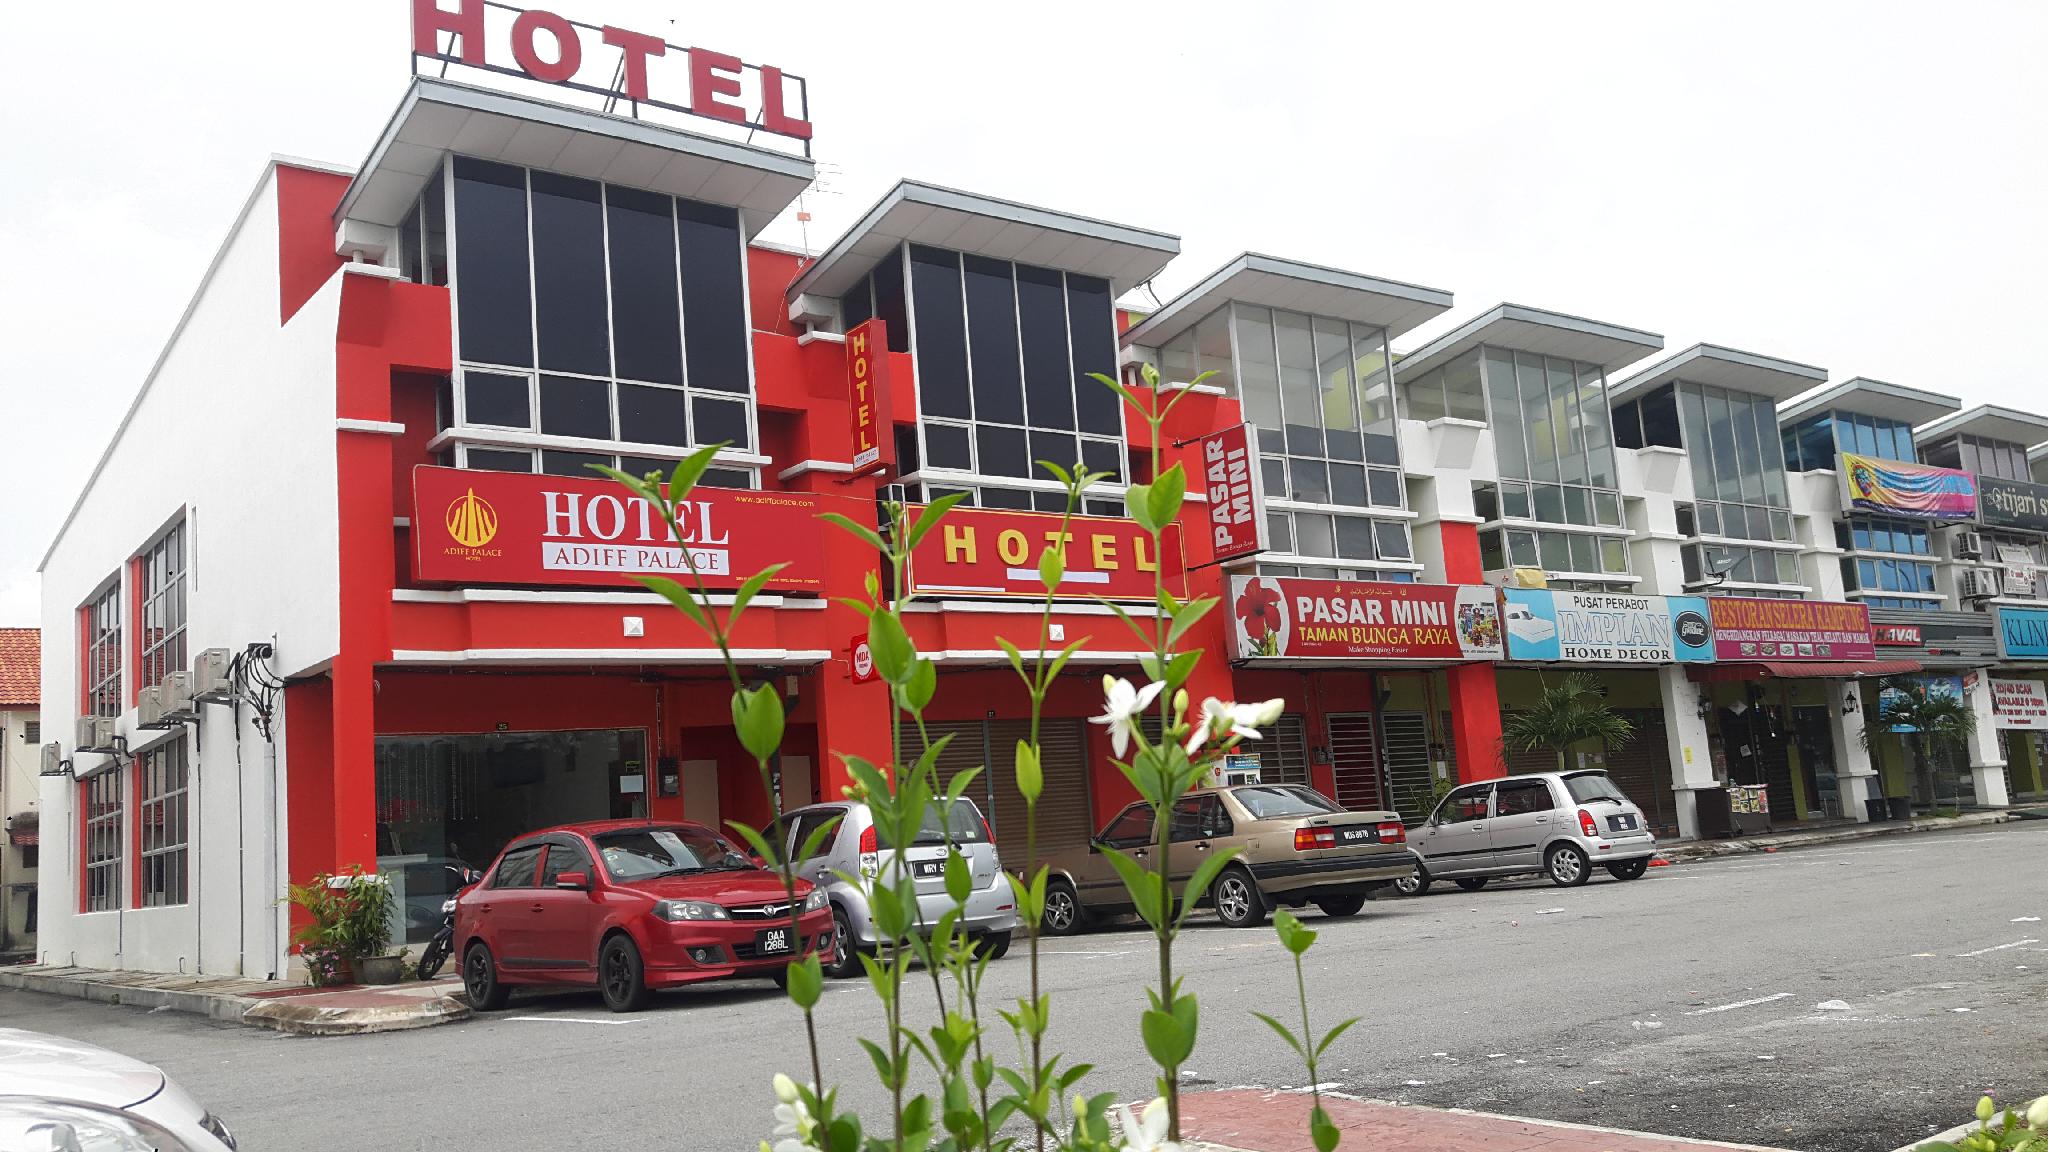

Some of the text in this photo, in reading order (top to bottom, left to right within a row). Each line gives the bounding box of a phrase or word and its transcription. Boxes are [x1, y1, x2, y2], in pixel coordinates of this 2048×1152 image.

[411, 0, 813, 140] HOTEL
[853, 332, 871, 452] HOTEL
[1205, 436, 1233, 548] PASAR
[1227, 447, 1252, 525] MINI
[540, 491, 729, 545] HOTEL
[443, 547, 503, 558] ADIFF PALACE
[554, 547, 719, 571] ADIFF PALACE
[943, 524, 1160, 573] HOTEL
[1296, 596, 1448, 626] PASAR MINI
[1573, 595, 1649, 611] PUSAT PERABOT
[1299, 626, 1453, 645] TAMAN BUNGA RAYA
[1557, 610, 1670, 648] IMPIAN
[1565, 647, 1672, 661] HOME DECOR
[923, 863, 937, 874] WRY
[764, 939, 788, 952] 1288L
